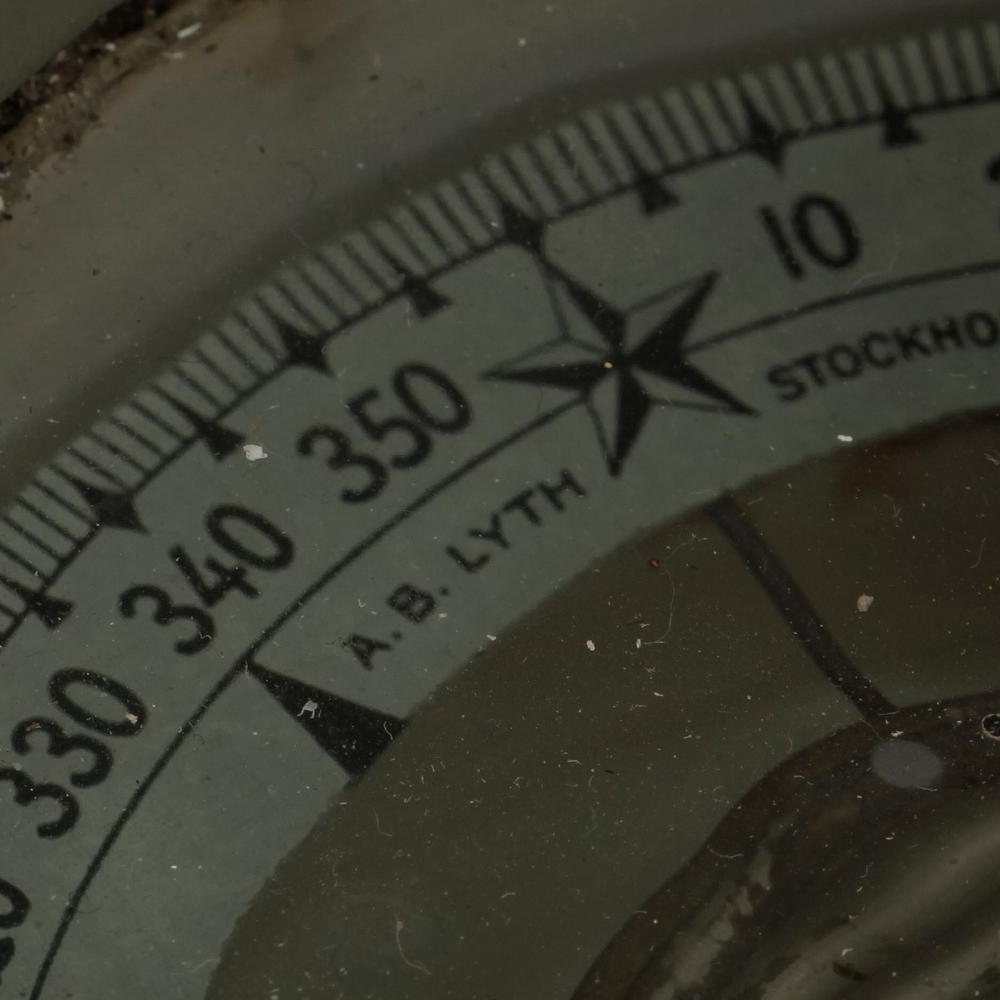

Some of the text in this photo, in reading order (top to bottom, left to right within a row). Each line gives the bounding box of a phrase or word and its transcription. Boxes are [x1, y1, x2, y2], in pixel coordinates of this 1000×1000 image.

[759, 194, 862, 282] 10
[296, 360, 475, 506] 350
[120, 501, 296, 657] 340
[446, 468, 590, 576] LYTH
